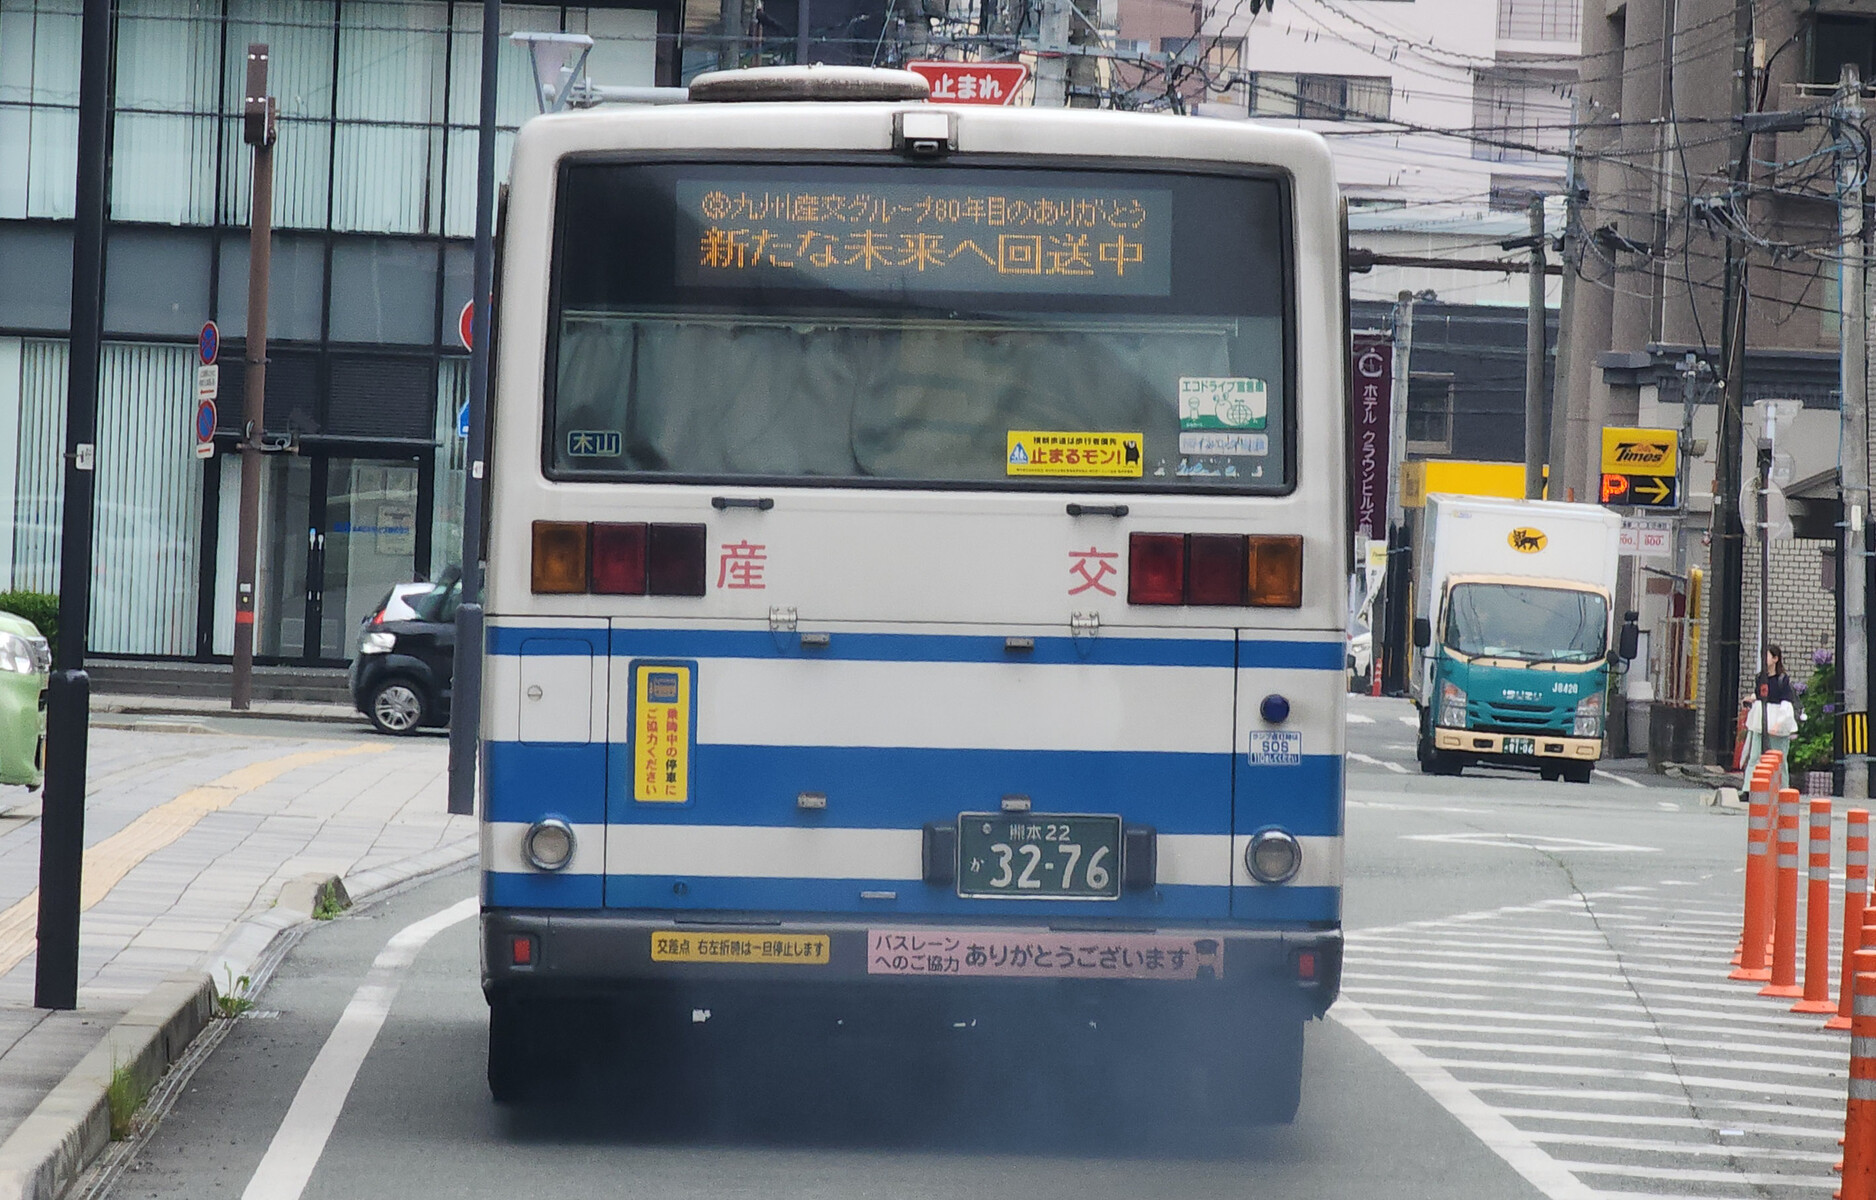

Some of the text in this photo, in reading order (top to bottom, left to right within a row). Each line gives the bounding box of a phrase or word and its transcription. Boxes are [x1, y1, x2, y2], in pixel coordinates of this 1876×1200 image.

[931, 73, 1003, 99] 止まれ
[700, 226, 1144, 277] 新たな未来へ回送中
[1362, 384, 1379, 424] ホテル
[573, 432, 617, 455] 木山
[1029, 447, 1122, 466] 止まるモン!
[1615, 442, 1669, 463] Times
[1601, 473, 1629, 503] P
[717, 539, 1119, 597] 産 交
[645, 707, 659, 796] ご協力ください
[1262, 740, 1289, 753] SOS
[970, 843, 1110, 889] か 32-76
[657, 938, 824, 957] 交差点 右左折時は一旦停止します
[875, 935, 960, 953] バスレーン
[965, 942, 1190, 970] ありがとうございます
[874, 954, 960, 974] へのご協力
